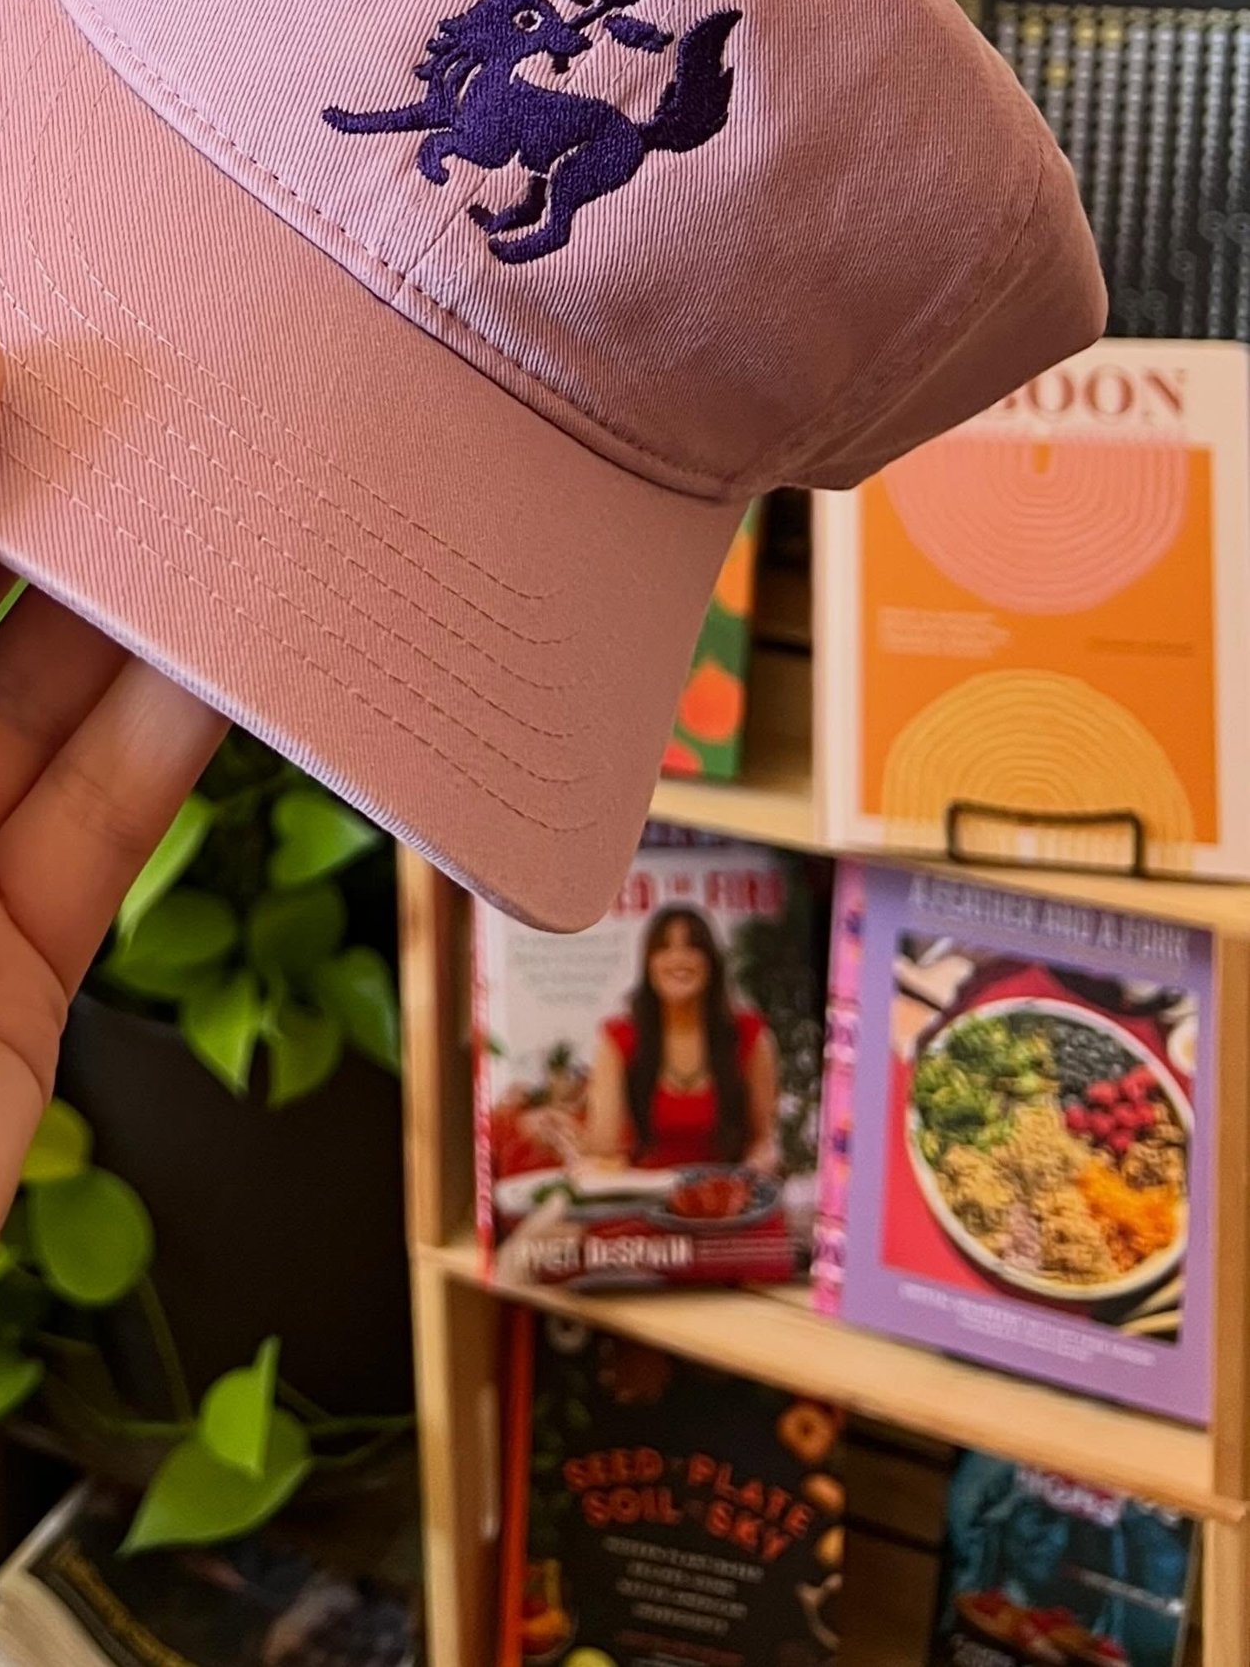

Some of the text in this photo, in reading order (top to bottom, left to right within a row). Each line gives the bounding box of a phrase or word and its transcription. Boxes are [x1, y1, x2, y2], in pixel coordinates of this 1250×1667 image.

[998, 364, 1188, 422] OON
[563, 1447, 663, 1492] SEED
[688, 1453, 812, 1537] PLATE
[582, 1487, 680, 1527] SOIL
[706, 1500, 788, 1563] SKY
